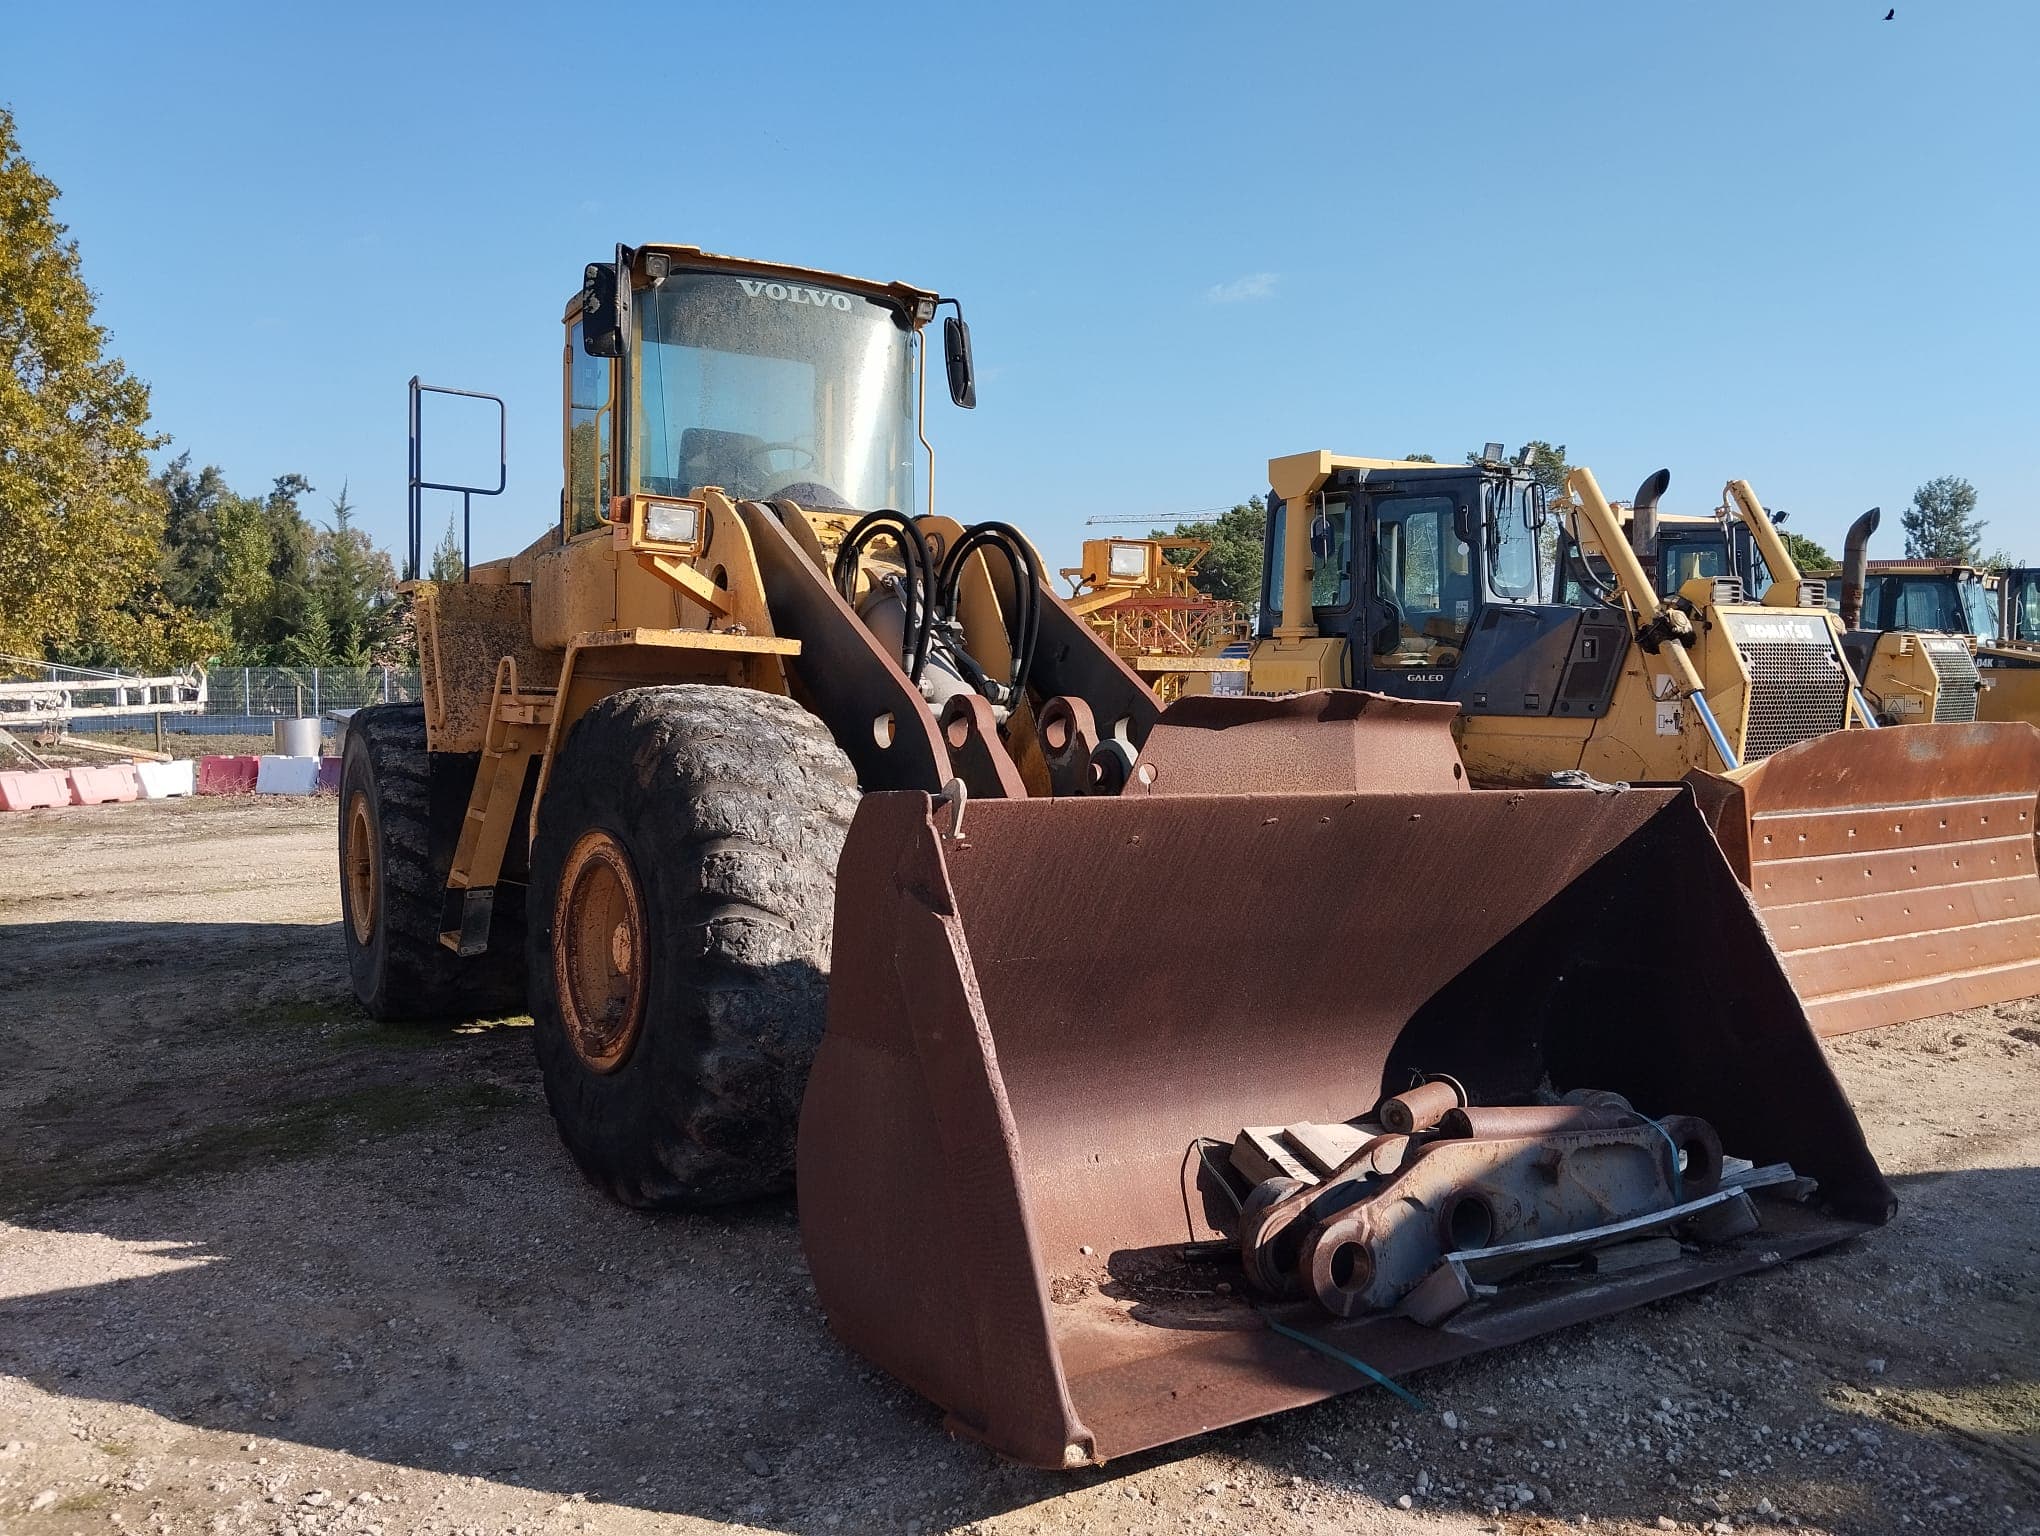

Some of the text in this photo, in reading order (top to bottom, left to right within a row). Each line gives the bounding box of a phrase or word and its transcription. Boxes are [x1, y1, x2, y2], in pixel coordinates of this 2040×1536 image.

[736, 279, 852, 311] VOLVO
[1744, 621, 1814, 639] KOMATSU
[1407, 674, 1444, 682] GALEO
